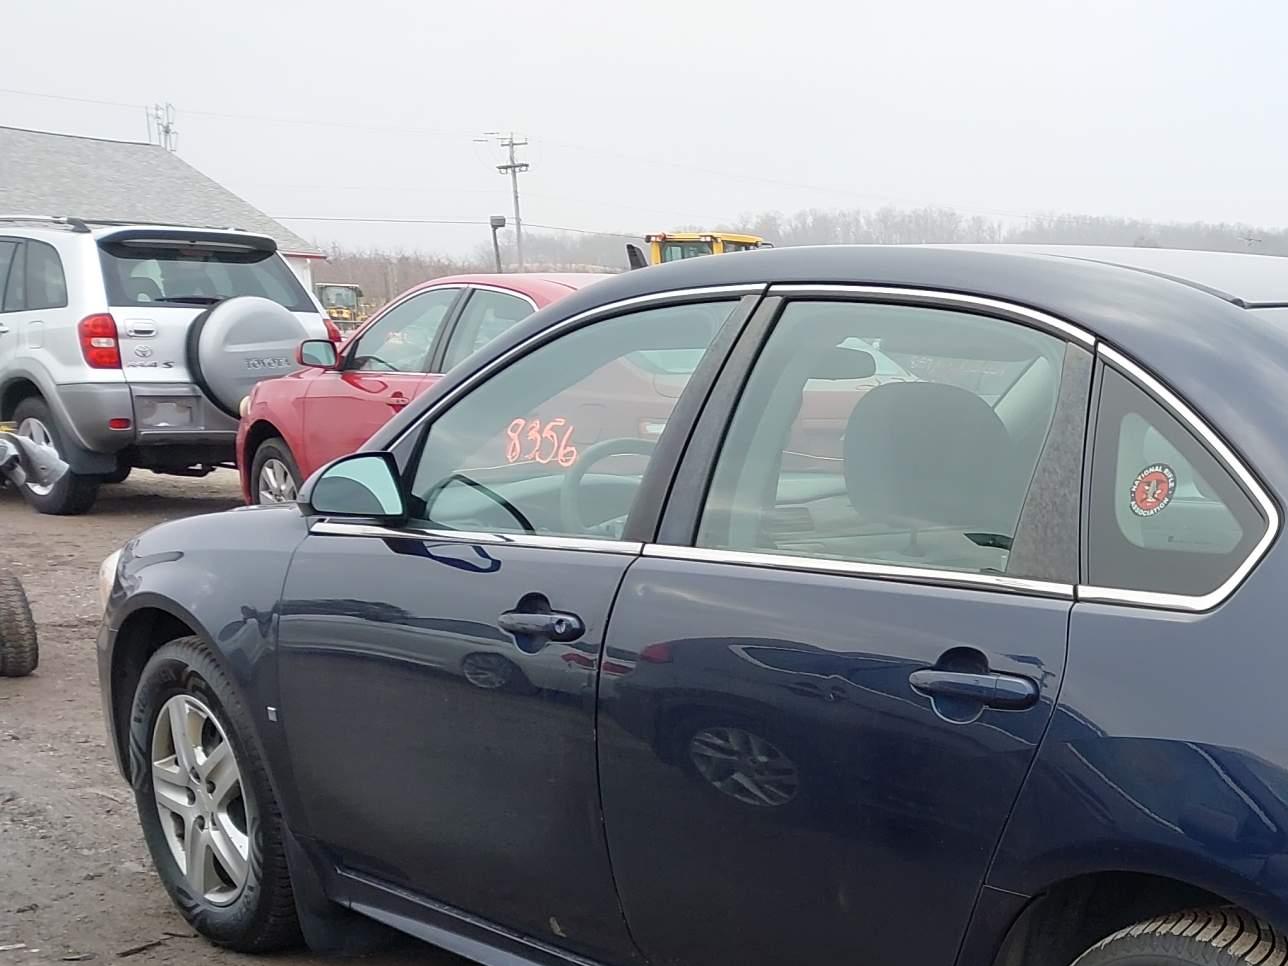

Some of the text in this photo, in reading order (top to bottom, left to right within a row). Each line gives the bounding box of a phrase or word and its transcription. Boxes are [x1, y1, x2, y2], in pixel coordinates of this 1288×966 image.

[245, 357, 291, 370] TOYOTA
[506, 417, 577, 467] 8356
[1131, 466, 1175, 491] NATIONAL RIFLE
[1130, 497, 1169, 516] ASSOCIATION
